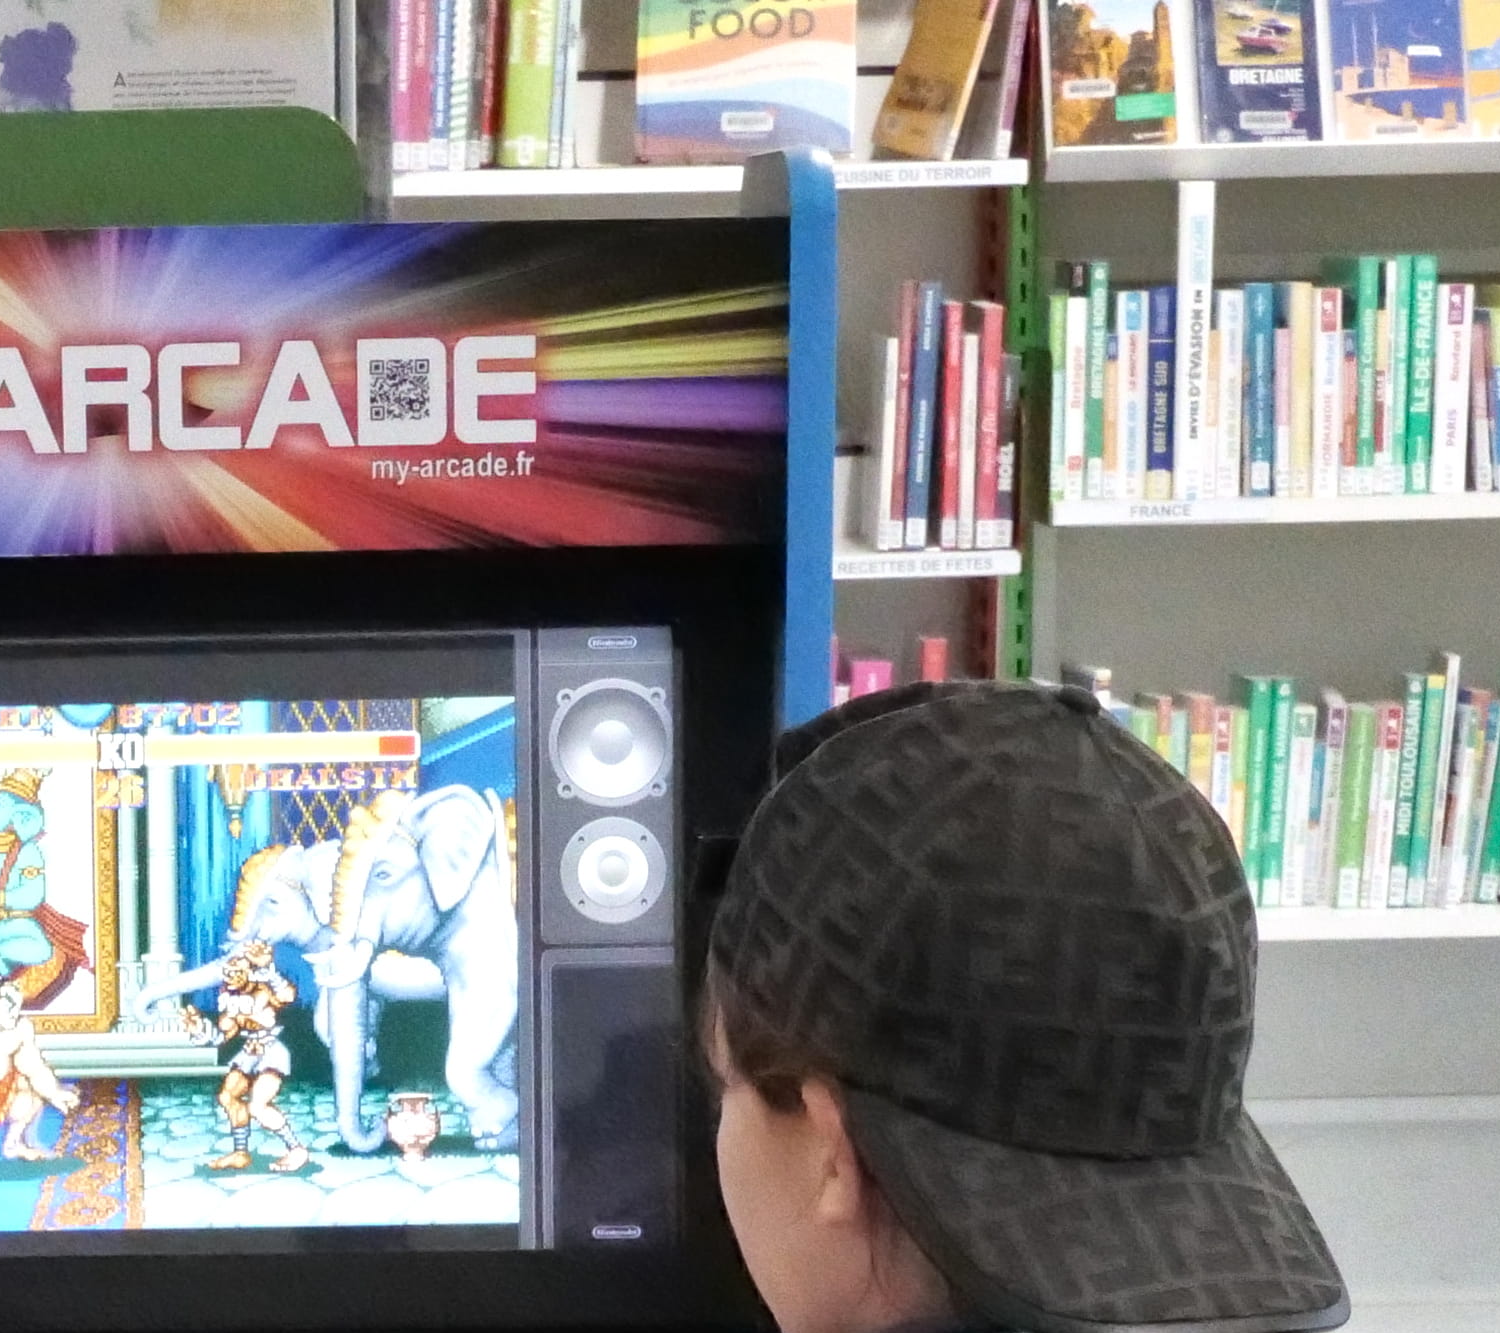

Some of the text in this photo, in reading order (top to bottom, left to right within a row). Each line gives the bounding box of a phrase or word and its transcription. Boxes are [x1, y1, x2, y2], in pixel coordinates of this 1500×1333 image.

[689, 8, 815, 39] FOOD
[1229, 67, 1304, 84] BRETAGNE
[898, 169, 920, 182] DU
[925, 166, 992, 181] TERROIR
[1409, 280, 1433, 413] ÎLE-DE-FRANCE
[1445, 330, 1462, 447] PARIS Routard
[370, 451, 535, 483] my-arcade.fr
[1129, 504, 1192, 518] FRANCE
[837, 557, 993, 575] RECETTES DE FETES
[98, 734, 145, 769] KO
[1397, 699, 1420, 837] MIDI TOULOUSAIN
[97, 772, 144, 808] 26
